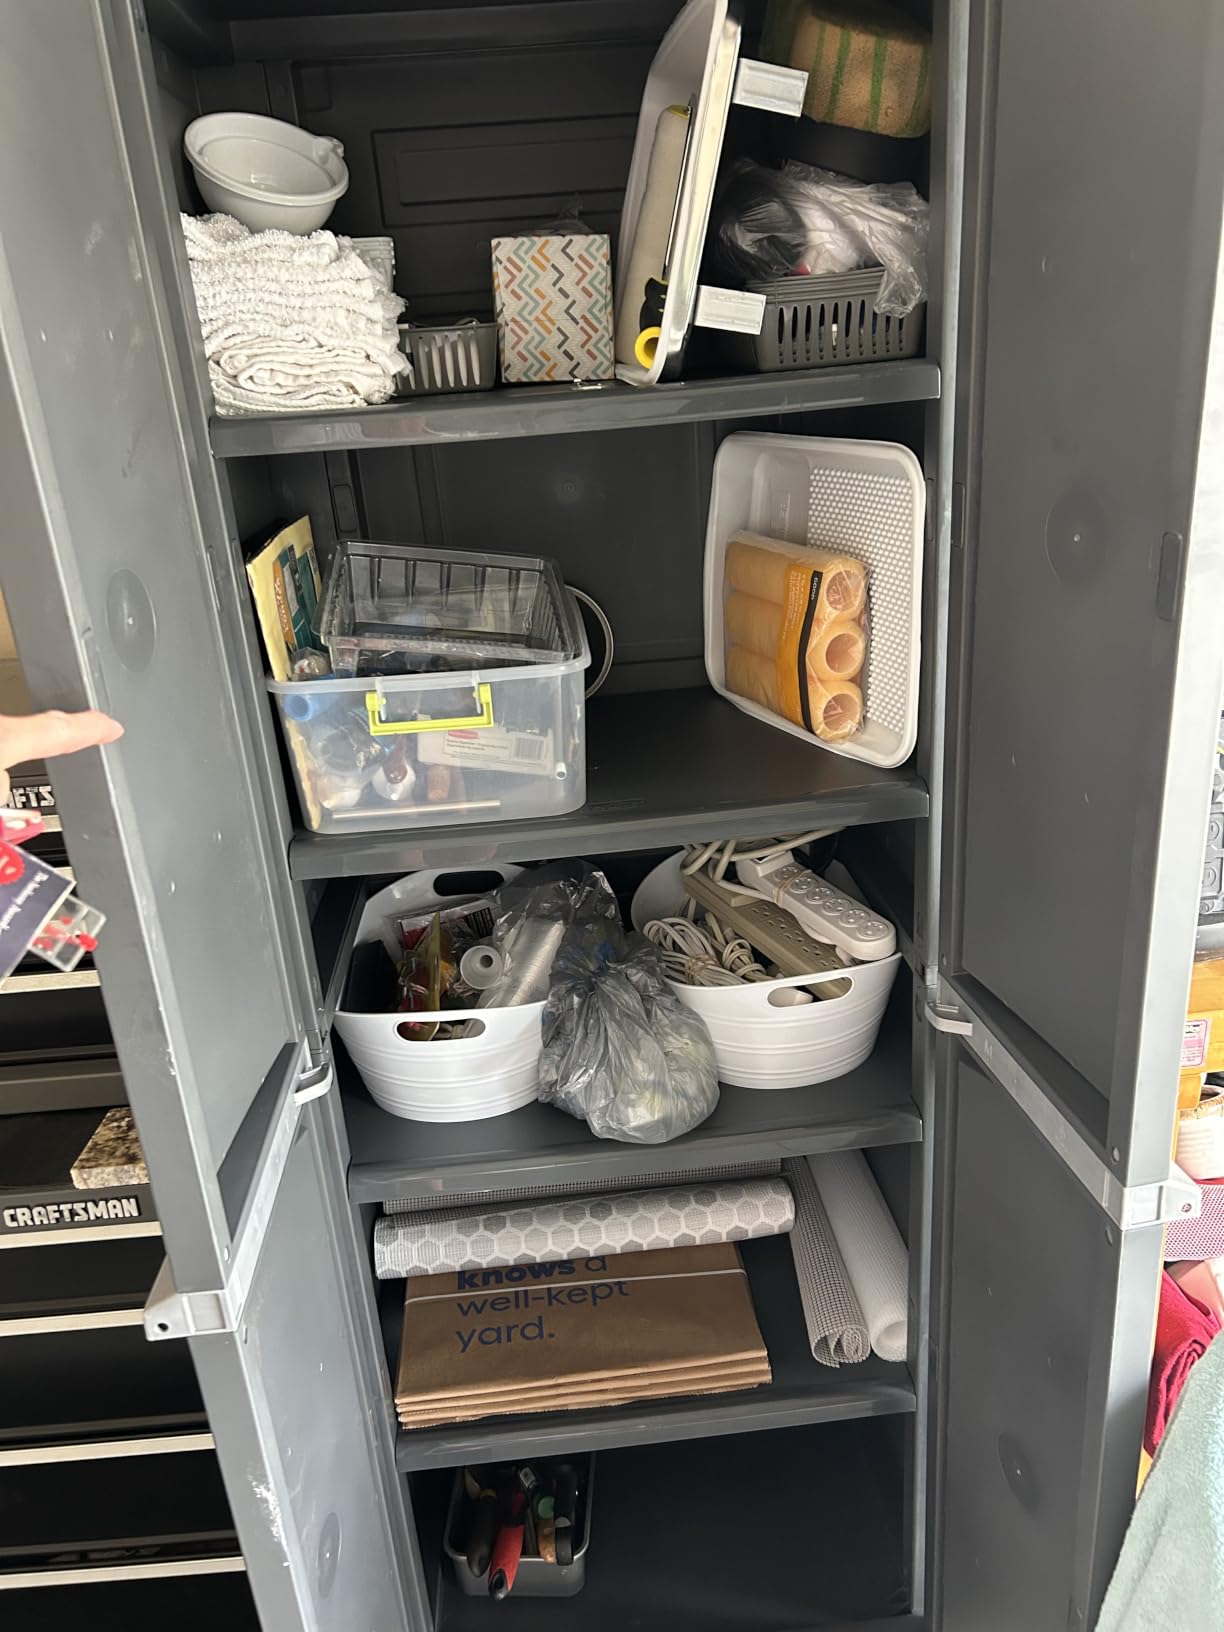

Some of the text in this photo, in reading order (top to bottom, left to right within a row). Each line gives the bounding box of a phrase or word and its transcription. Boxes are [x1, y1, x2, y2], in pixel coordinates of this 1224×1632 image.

[3, 1198, 139, 1227] CRAFTSMAN
[457, 1255, 608, 1290] knows a
[456, 1280, 630, 1317] well-kept
[455, 1314, 556, 1354] yard.
